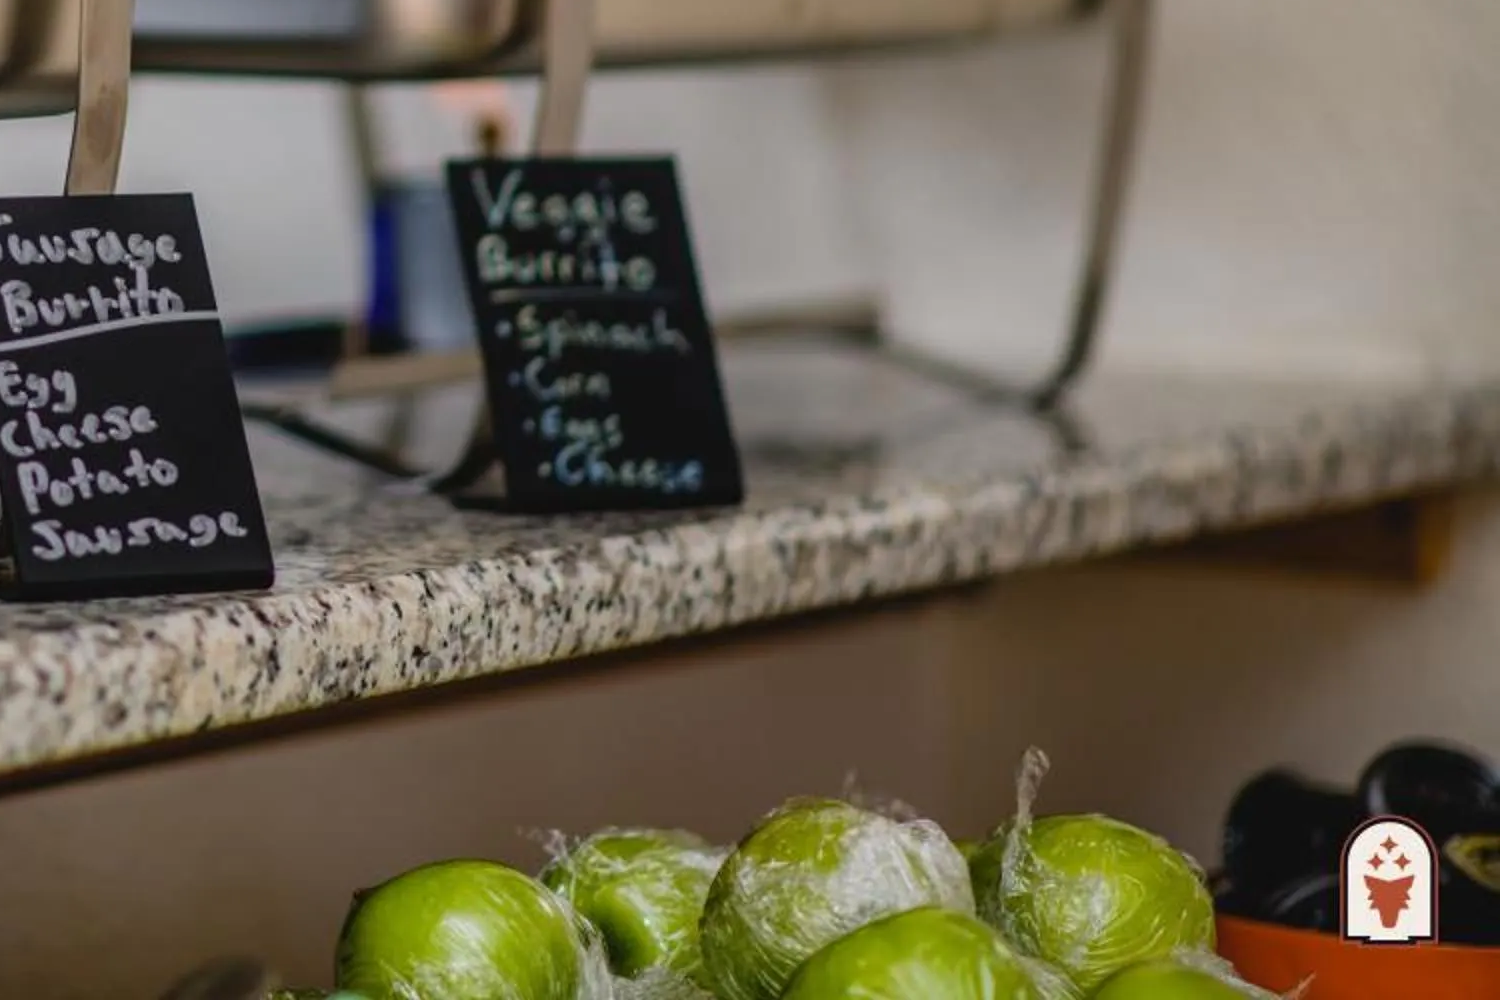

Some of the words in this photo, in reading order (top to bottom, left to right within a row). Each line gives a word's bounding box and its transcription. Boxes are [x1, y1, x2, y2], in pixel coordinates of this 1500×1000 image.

[470, 168, 658, 242] Veggie
[477, 233, 657, 292] Burrito
[0, 262, 184, 333] Burrito
[0, 405, 158, 456] Cheese
[17, 448, 179, 514] Potato
[555, 440, 704, 493] Cheese
[32, 511, 247, 560] Sausage
